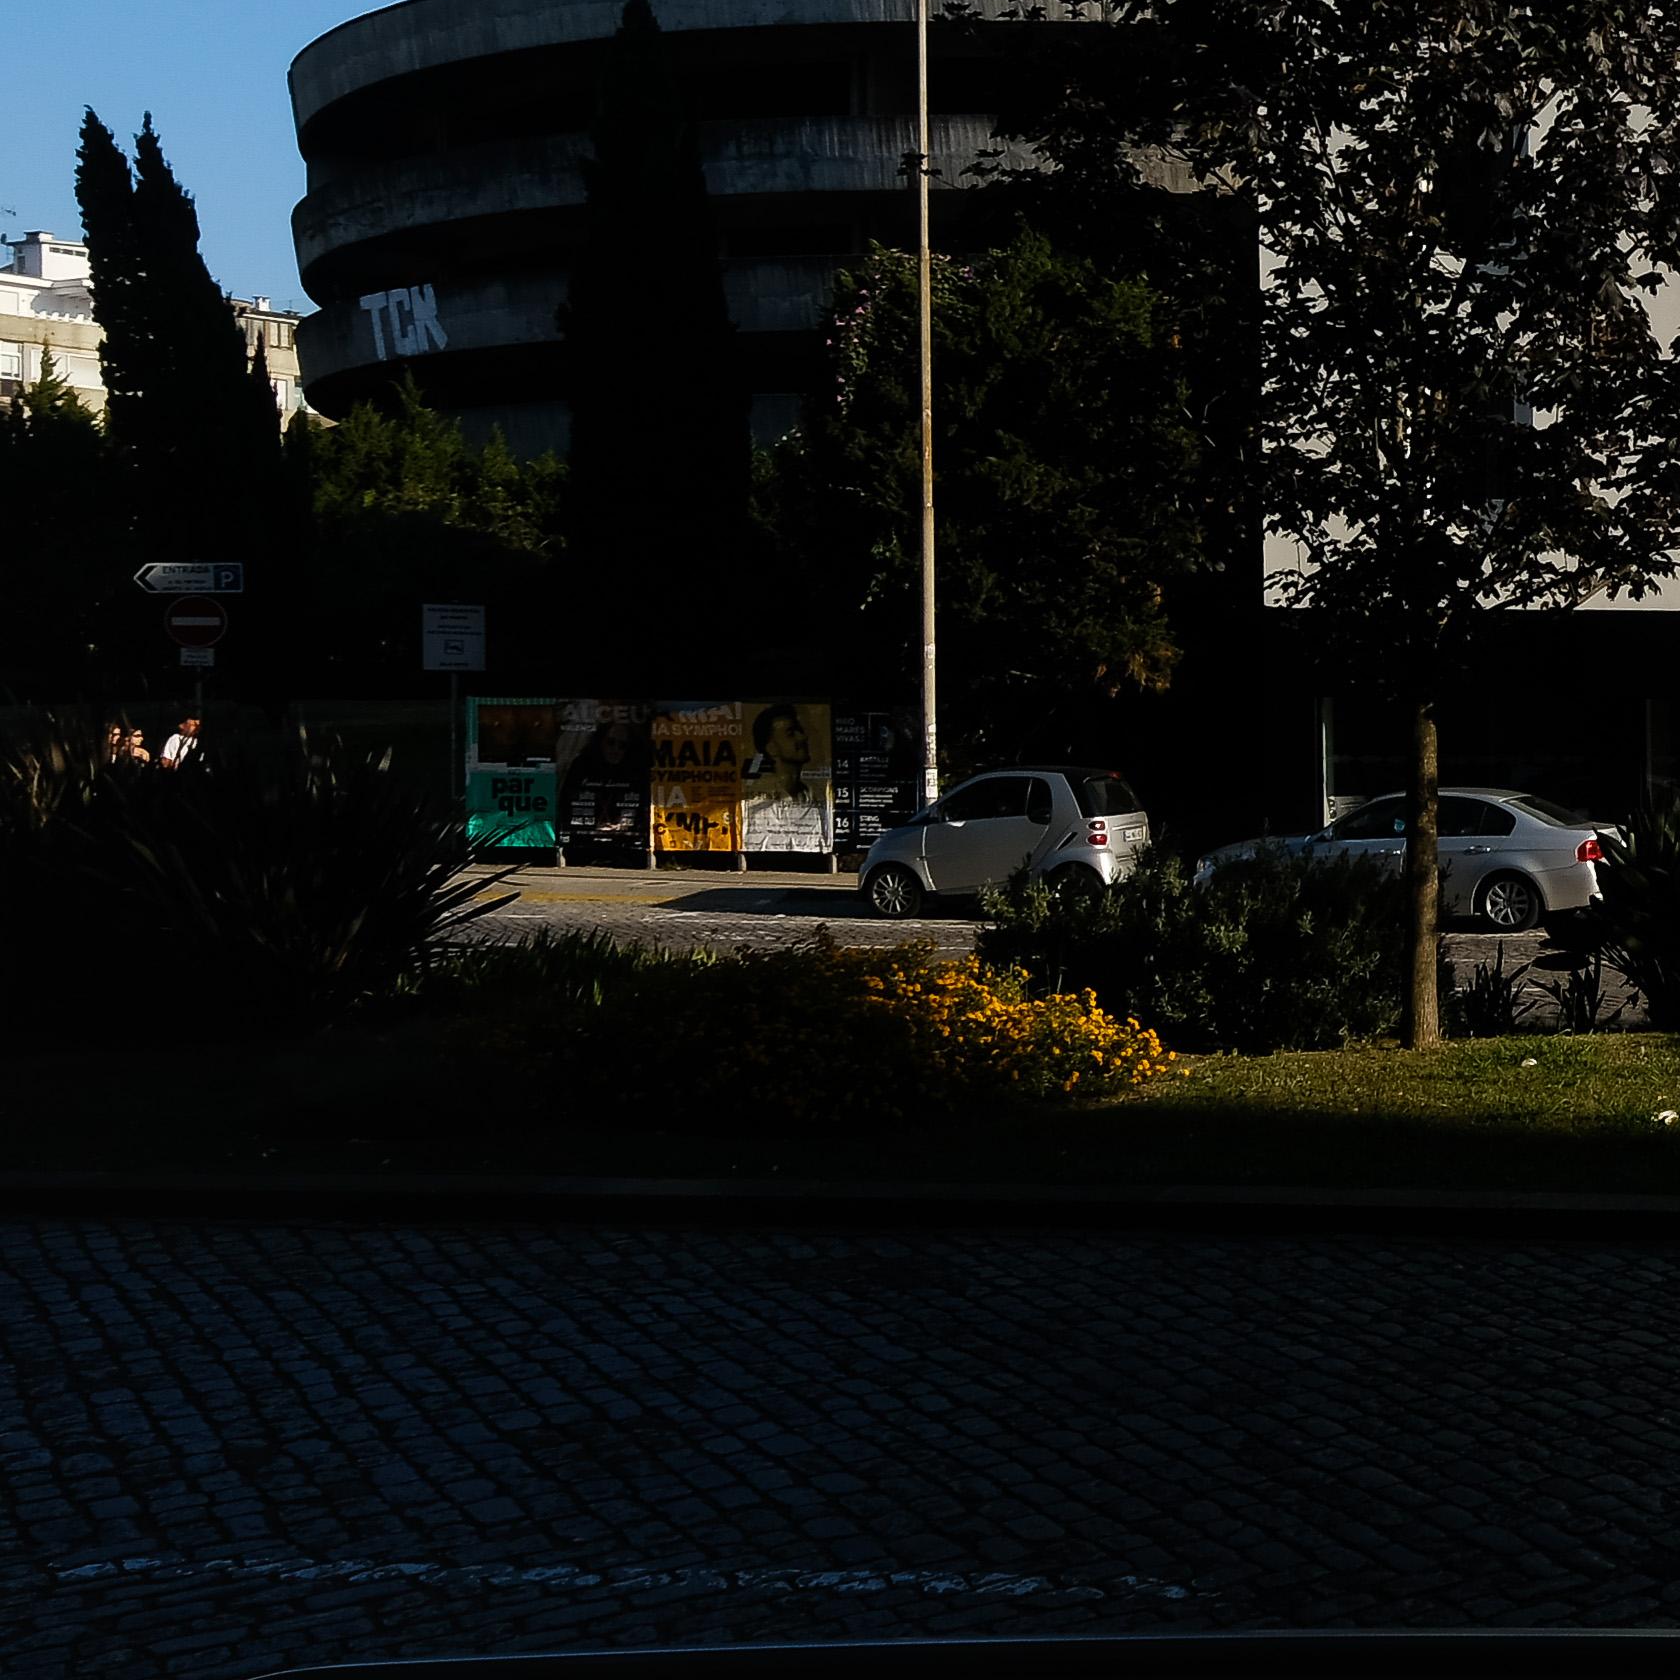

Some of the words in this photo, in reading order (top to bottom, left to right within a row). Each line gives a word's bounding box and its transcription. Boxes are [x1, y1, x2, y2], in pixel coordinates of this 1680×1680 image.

[220, 571, 235, 588] P
[492, 777, 534, 800] par
[836, 787, 849, 798] 15
[498, 795, 548, 817] que
[835, 817, 850, 828] 16
